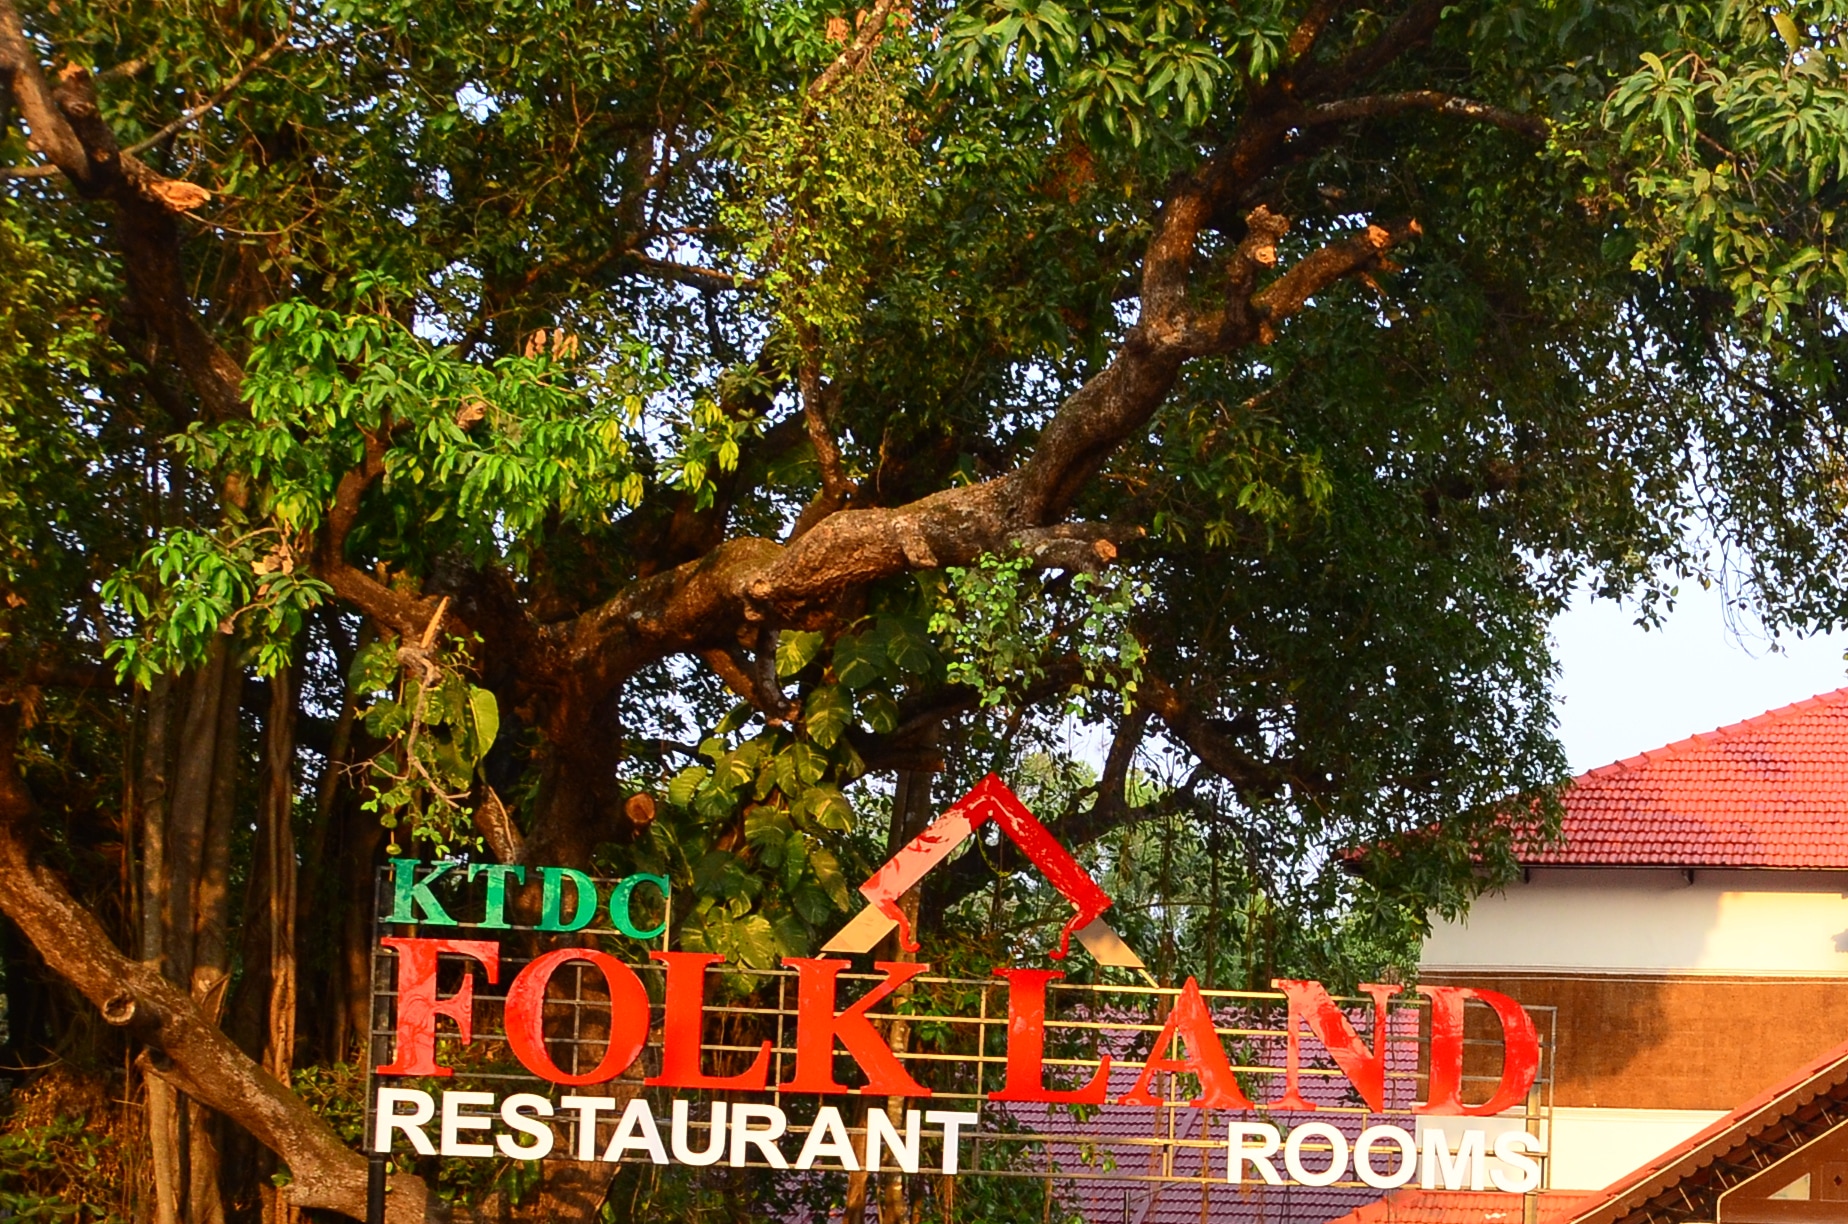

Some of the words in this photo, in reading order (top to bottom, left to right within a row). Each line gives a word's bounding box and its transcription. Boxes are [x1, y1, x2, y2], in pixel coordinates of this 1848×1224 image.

[384, 858, 670, 940] KTDC
[376, 937, 932, 1098] FOLK
[988, 967, 1540, 1117] LAND
[374, 1087, 979, 1176] RESTAURANT
[1226, 1120, 1542, 1195] ROOMS
